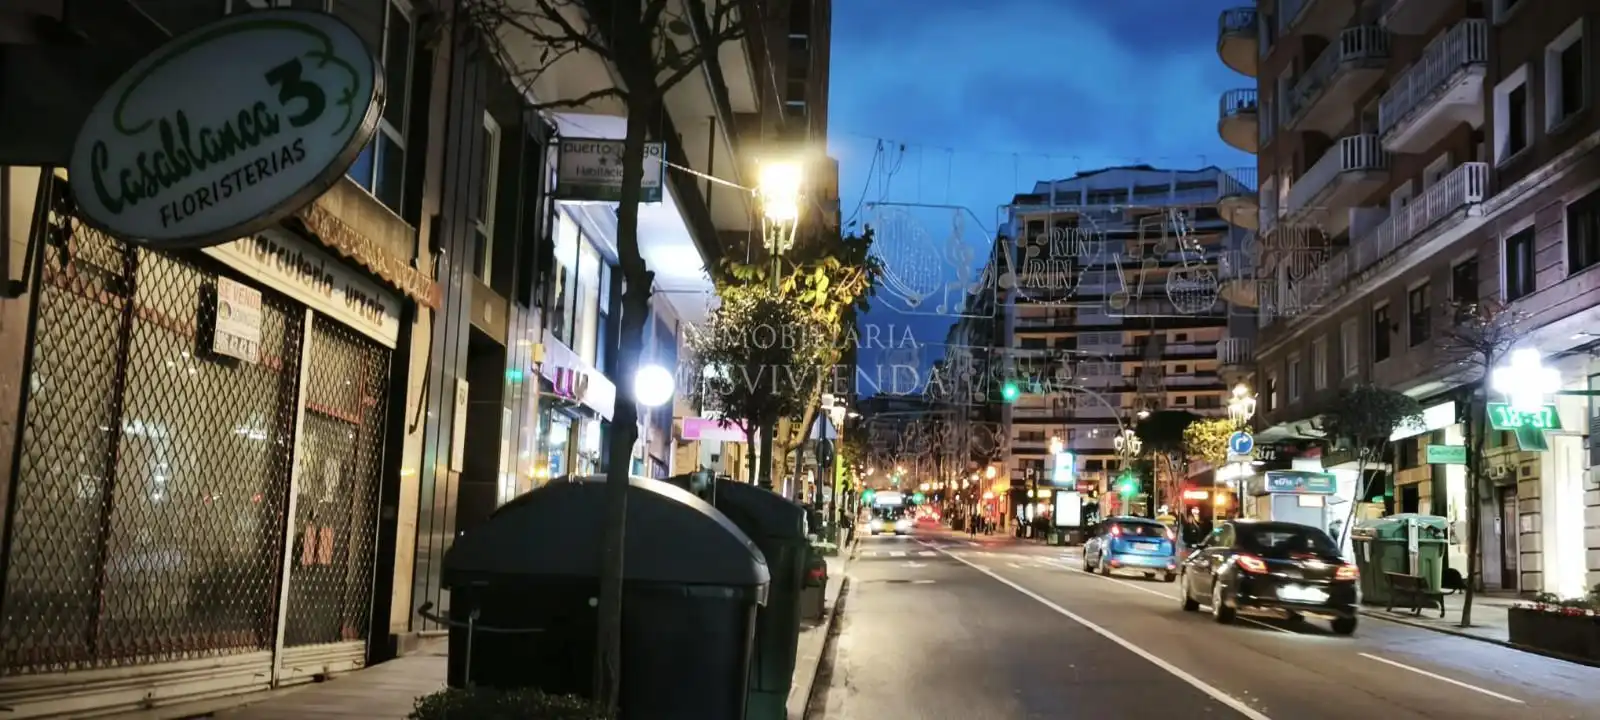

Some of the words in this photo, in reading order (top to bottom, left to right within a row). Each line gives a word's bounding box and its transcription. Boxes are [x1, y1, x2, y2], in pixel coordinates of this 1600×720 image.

[91, 101, 280, 215] Casablanca
[264, 56, 326, 128] 3
[159, 138, 306, 228] FLORISTERIAS
[1050, 227, 1093, 257] RIN
[1026, 259, 1073, 289] RIN
